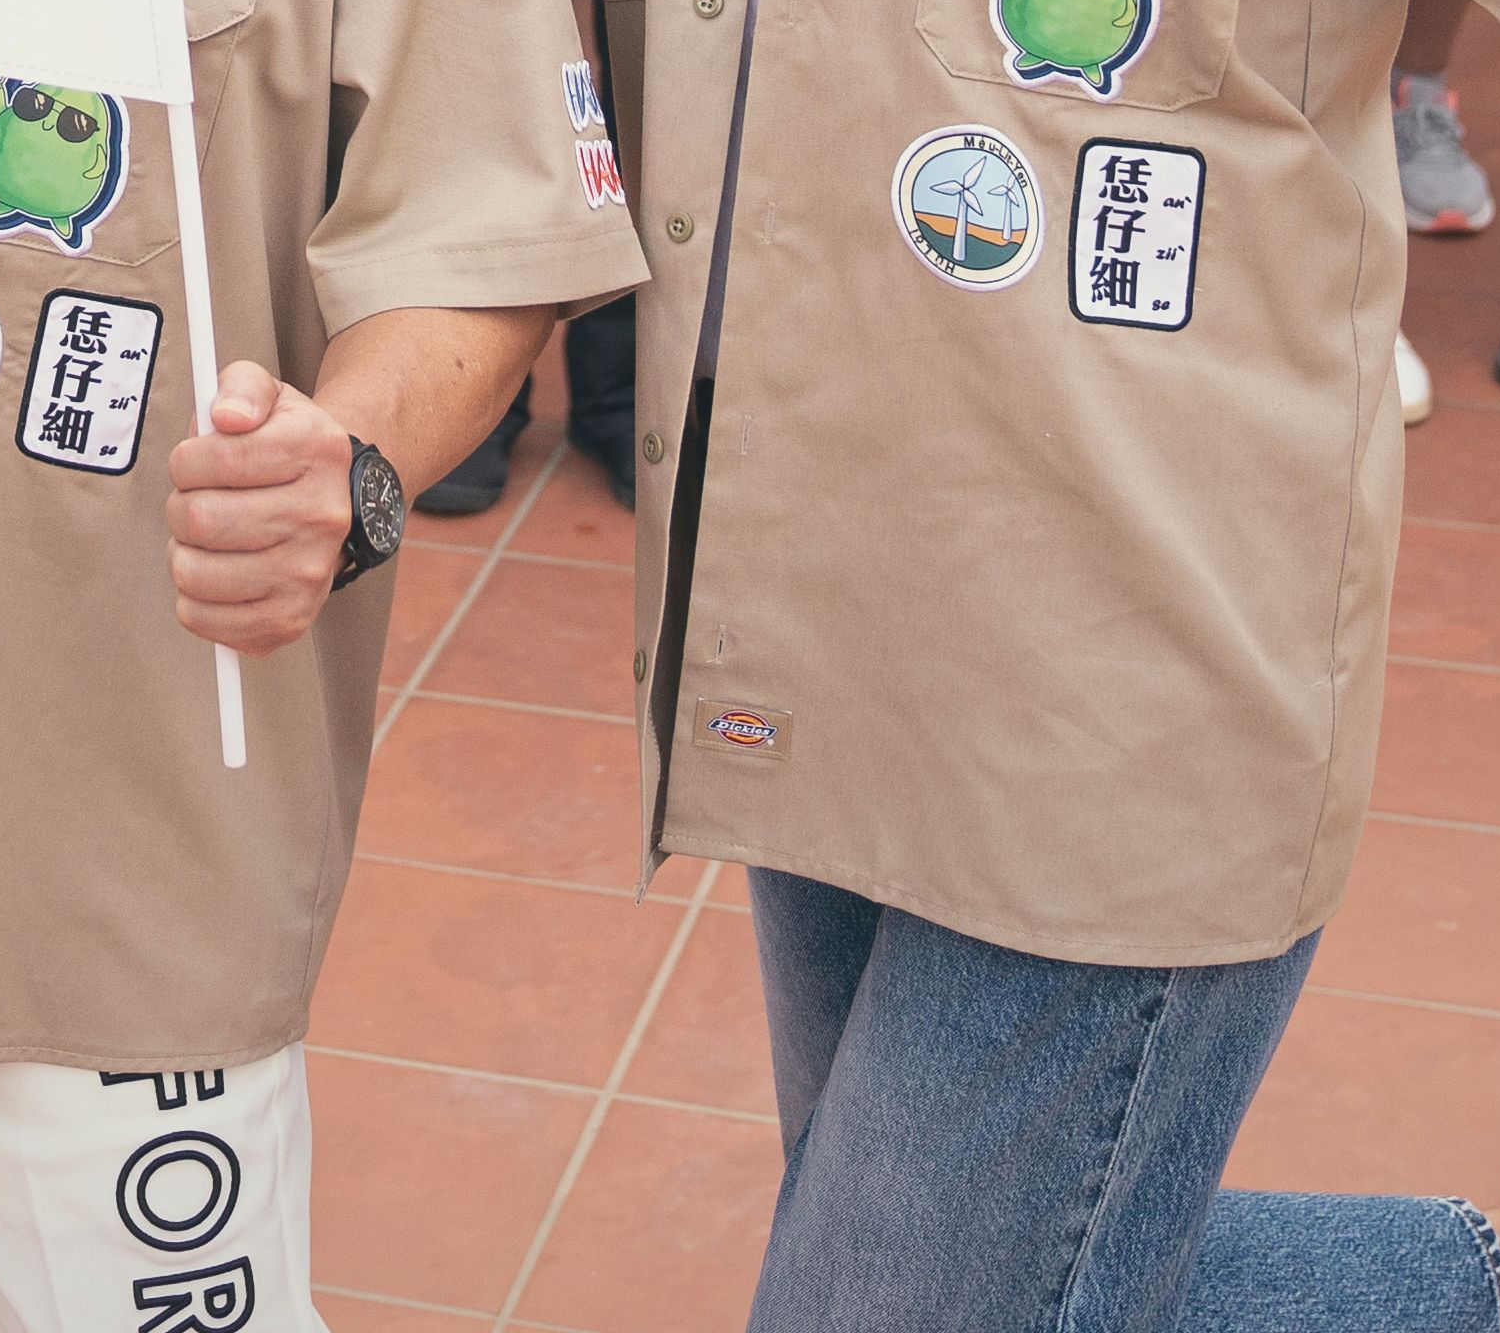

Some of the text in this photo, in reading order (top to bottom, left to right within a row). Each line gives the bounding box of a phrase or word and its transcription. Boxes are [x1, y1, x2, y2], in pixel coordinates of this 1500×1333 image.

[1089, 155, 1152, 309] 恁仔細
[38, 305, 113, 455] 恁仔細
[715, 720, 771, 737] Dickies
